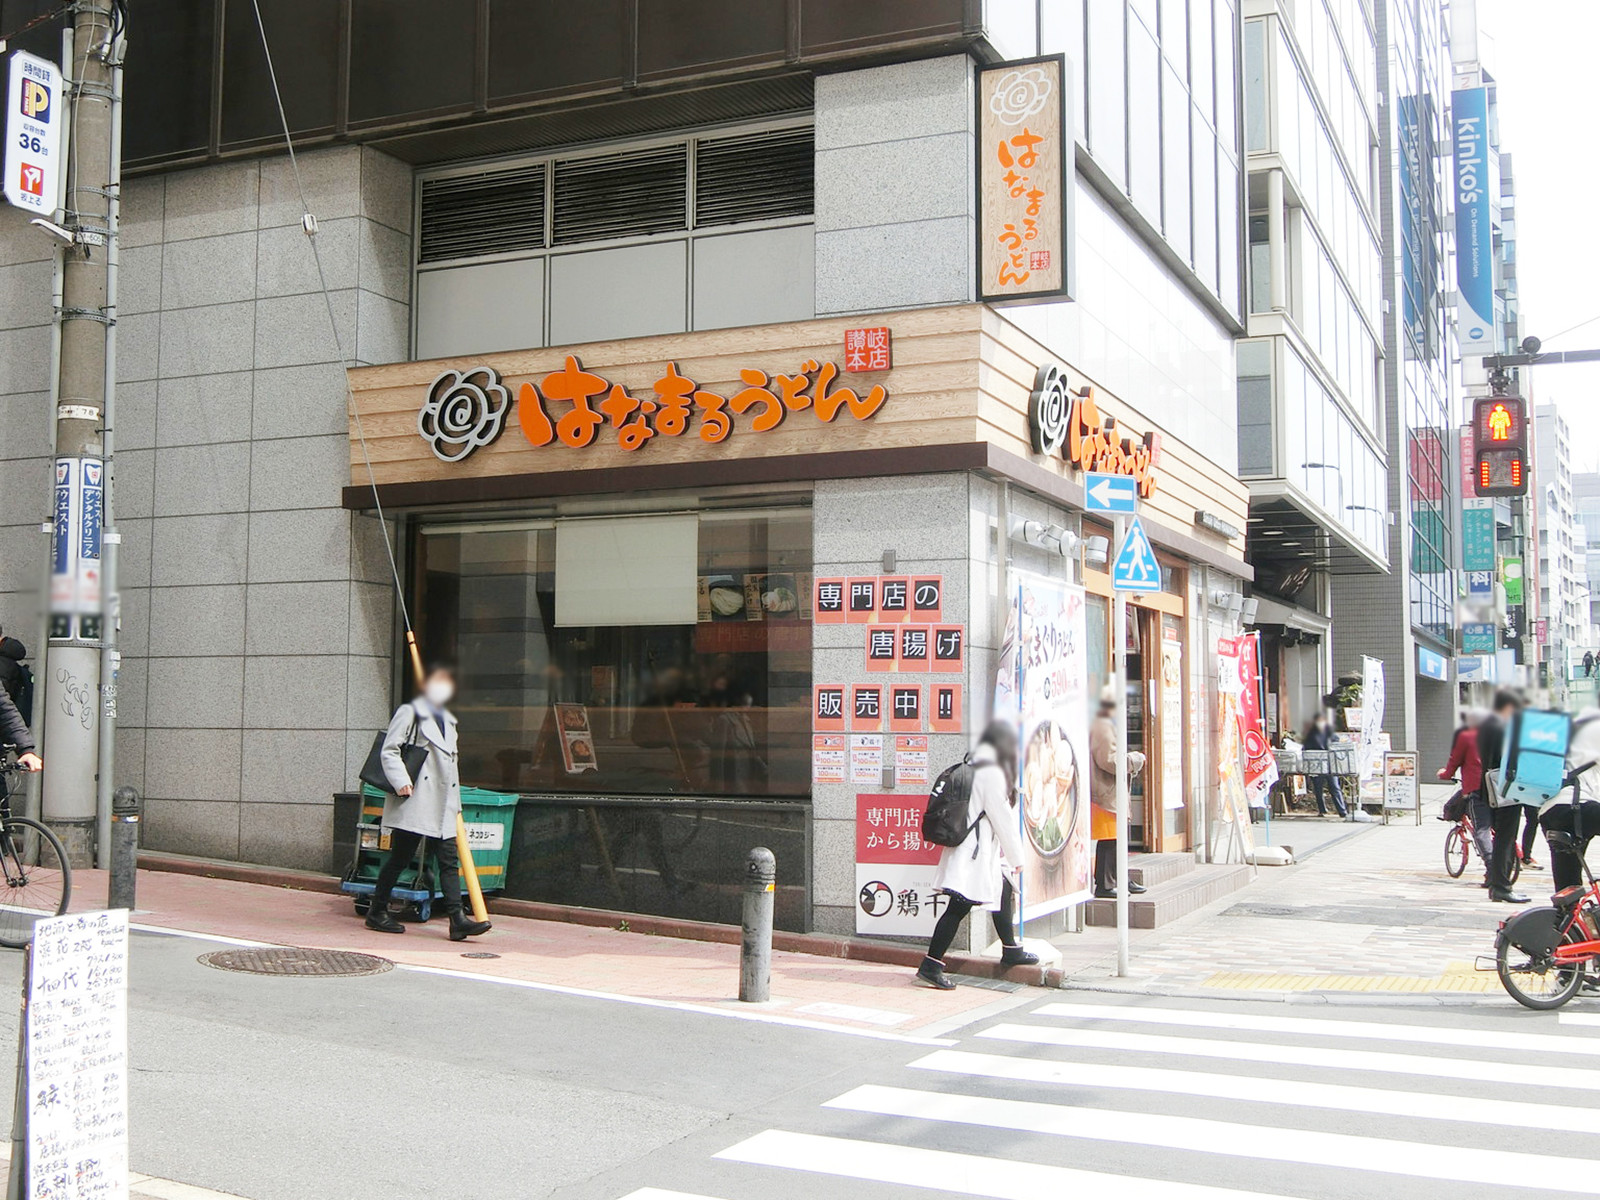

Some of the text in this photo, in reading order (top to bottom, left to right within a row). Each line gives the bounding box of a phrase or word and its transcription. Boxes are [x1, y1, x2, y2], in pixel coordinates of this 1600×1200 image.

[24, 61, 51, 82] 時間貸
[1457, 117, 1484, 205] kinko's
[997, 127, 1045, 287] はなまるうどん
[518, 354, 888, 450] はなまるうどん
[59, 489, 69, 536] ウエスト
[94, 490, 102, 529] ウエスト
[1470, 499, 1485, 508] 1F
[82, 489, 94, 558] デンタルクリニック
[817, 583, 940, 610] 専門店の
[869, 632, 962, 659] 唐揚げ
[866, 807, 920, 828] 専門店
[897, 889, 951, 919] 鶏千
